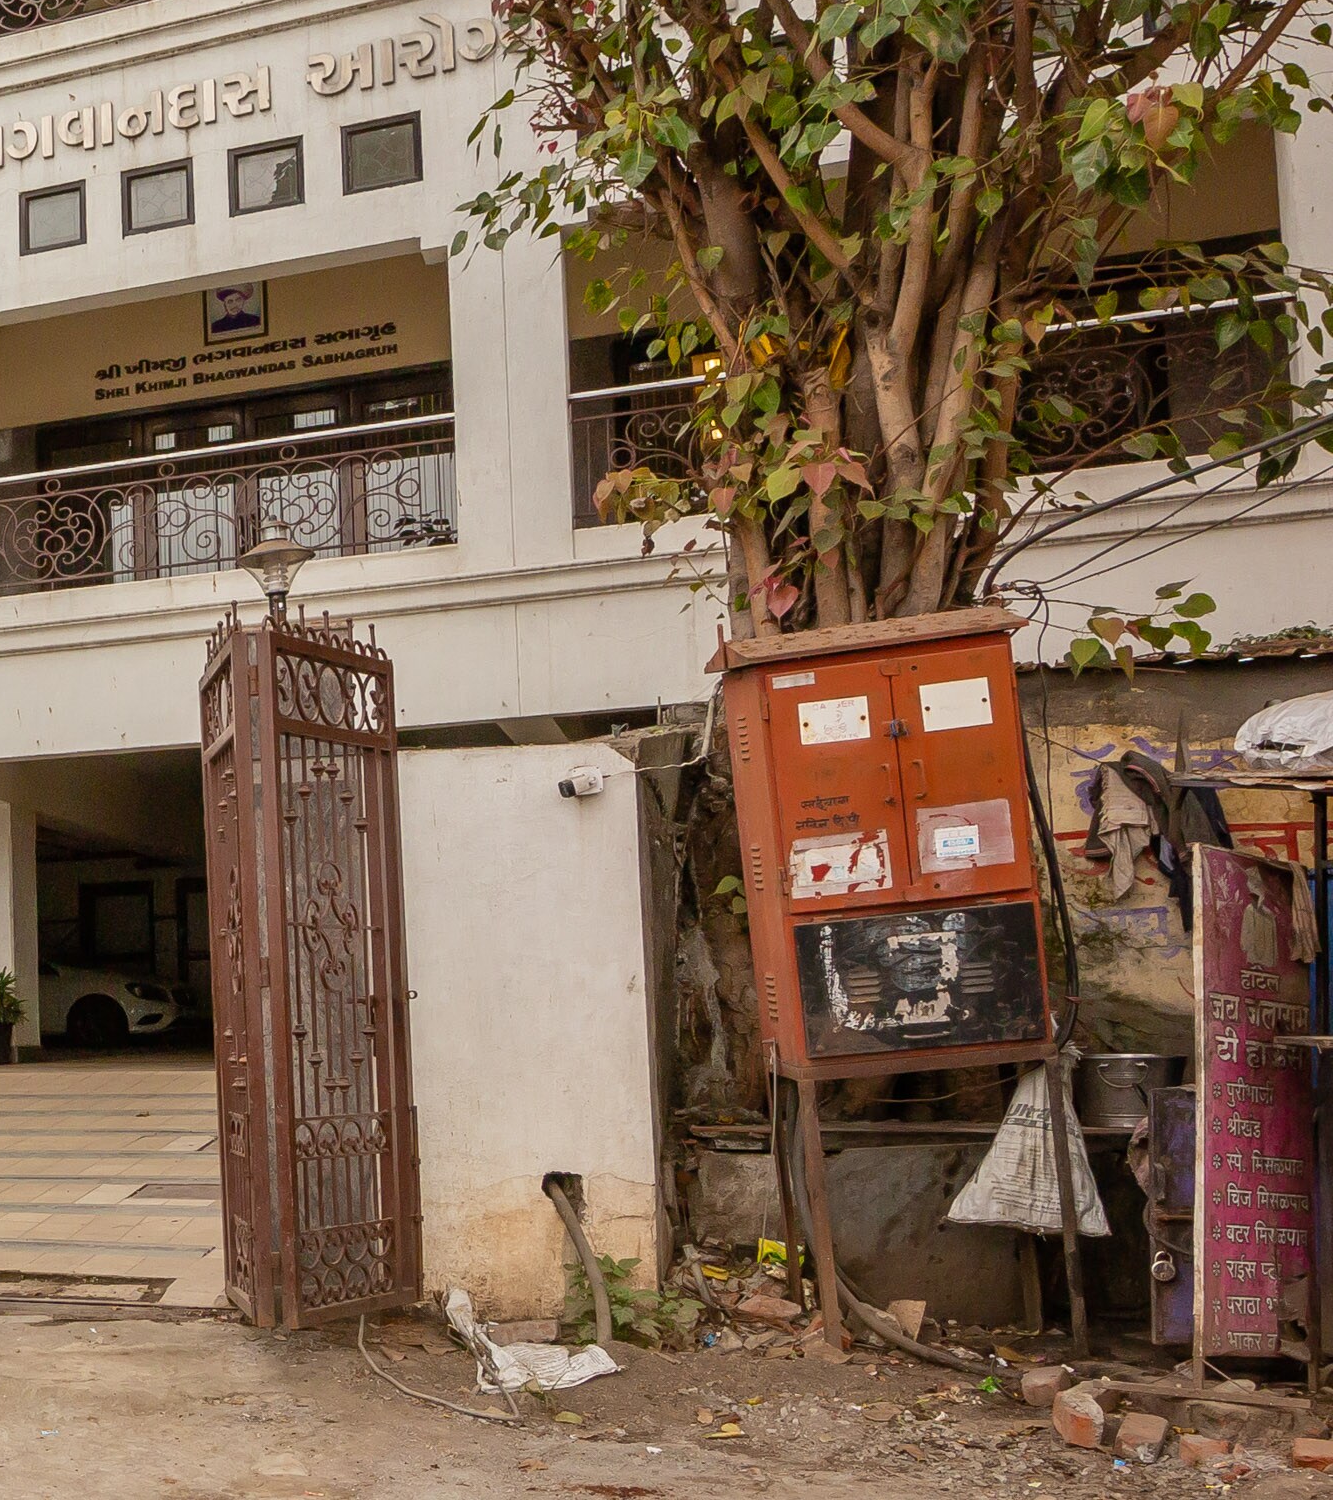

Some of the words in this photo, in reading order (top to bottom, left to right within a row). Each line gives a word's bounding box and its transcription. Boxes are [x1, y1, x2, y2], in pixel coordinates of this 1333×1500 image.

[94, 364, 121, 381] શ્રી
[124, 355, 187, 375] ખીમજી
[192, 336, 307, 366] ભગવાનદાસ
[313, 321, 397, 346] સભાગૃહ
[1209, 991, 1240, 1022] जय
[1215, 1026, 1239, 1064] टी
[1226, 1076, 1274, 1107] पुरीभाजी
[1227, 1111, 1262, 1139] श्रीखंड
[1227, 1182, 1252, 1208] चिज
[1256, 1185, 1309, 1211] मिसळपाव
[1226, 1223, 1250, 1243] बटर
[1226, 1255, 1256, 1282] राईस
[1227, 1295, 1261, 1316] पराठा
